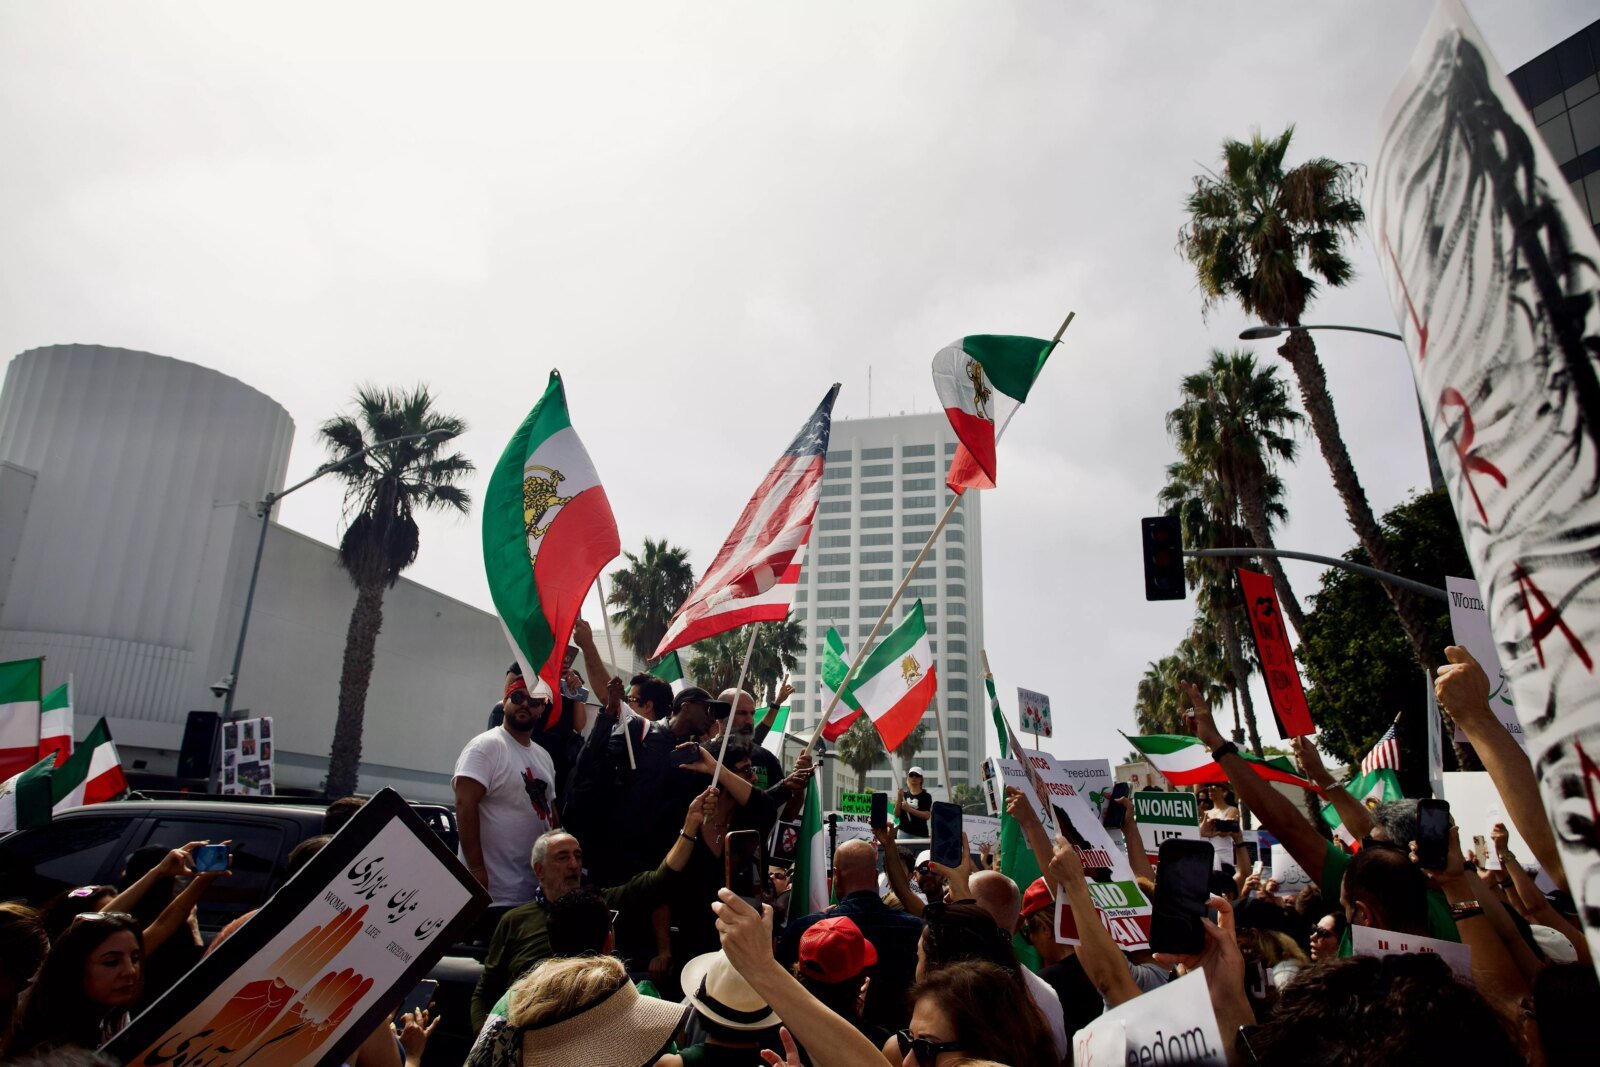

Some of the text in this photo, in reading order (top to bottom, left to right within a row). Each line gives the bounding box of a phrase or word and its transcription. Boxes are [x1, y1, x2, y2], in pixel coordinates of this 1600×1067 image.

[1002, 766, 1109, 778] Wom reedom.
[1137, 798, 1194, 819] WOMEN
[1074, 844, 1114, 869] Amini
[364, 924, 381, 940] LIFE
[385, 940, 413, 964] FREEDOM
